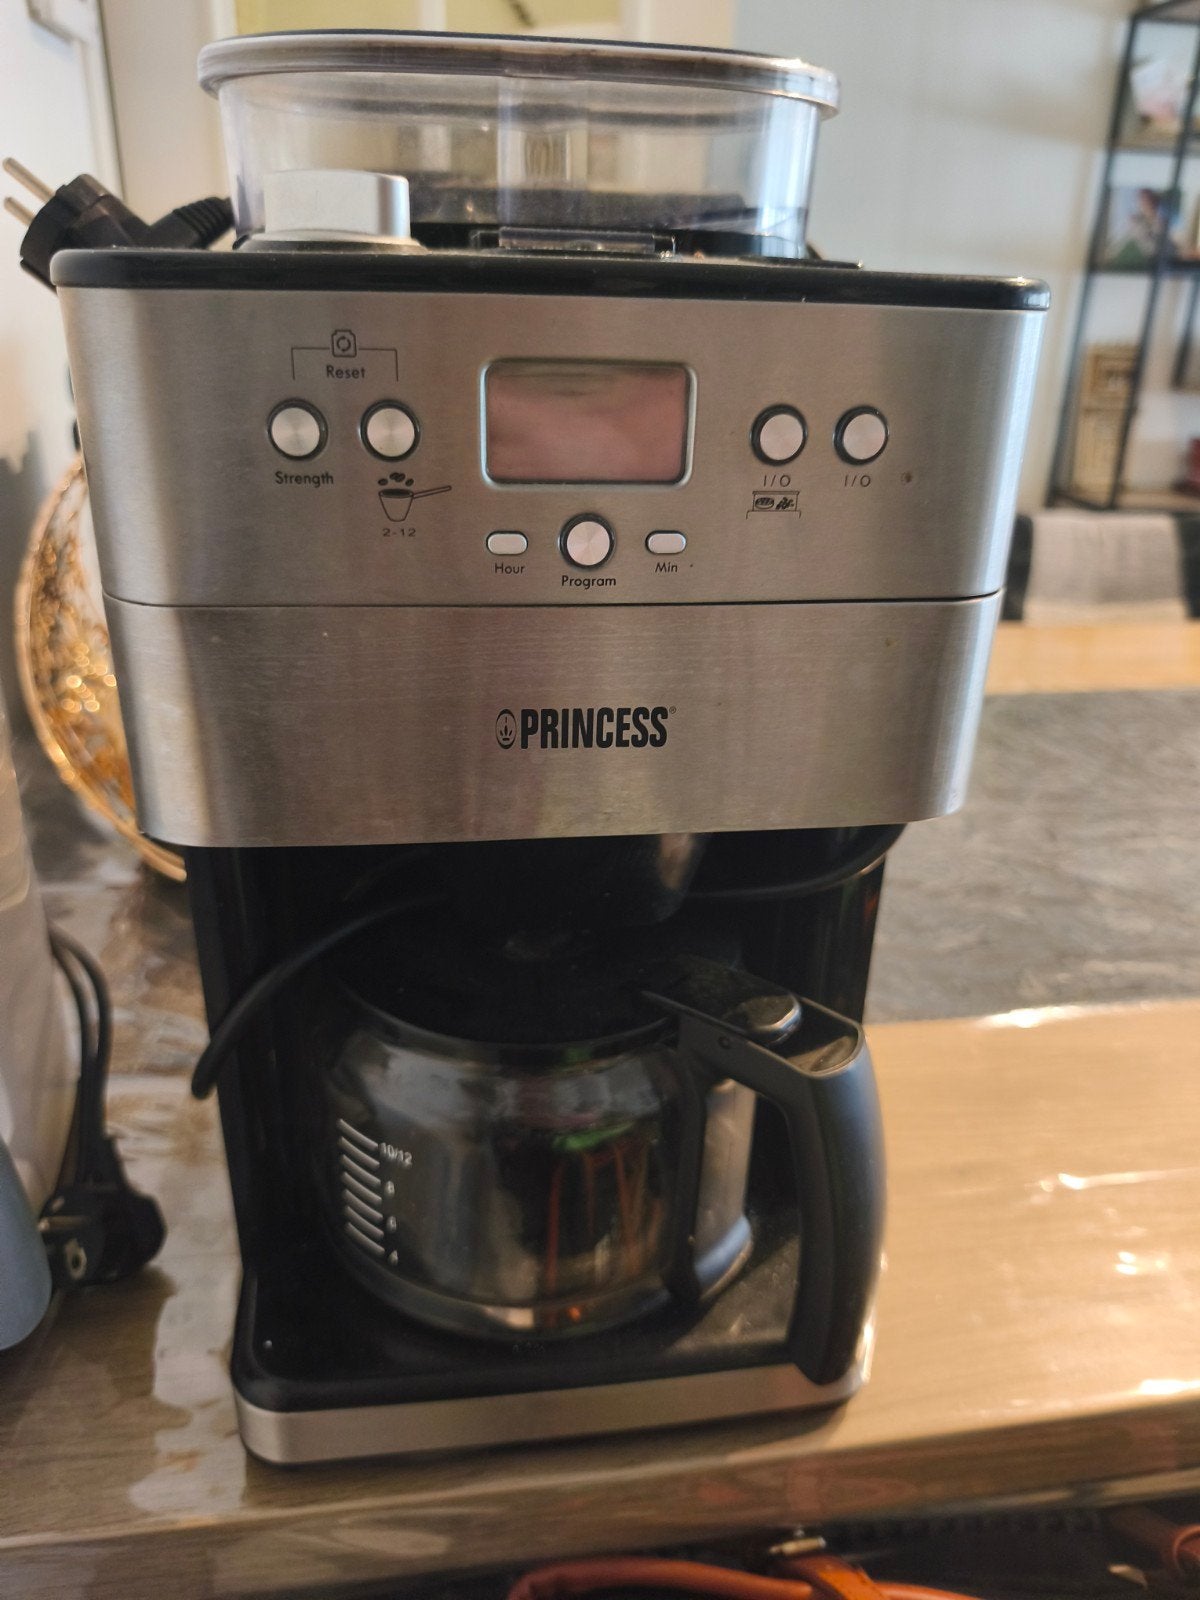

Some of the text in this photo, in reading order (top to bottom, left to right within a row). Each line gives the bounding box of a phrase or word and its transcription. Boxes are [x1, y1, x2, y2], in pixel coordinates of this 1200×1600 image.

[326, 364, 367, 379] Reset
[275, 471, 334, 488] Strength
[494, 563, 525, 575] Hour
[655, 561, 678, 573] Min
[561, 575, 616, 589] Program
[520, 706, 668, 749] PRINCESS
